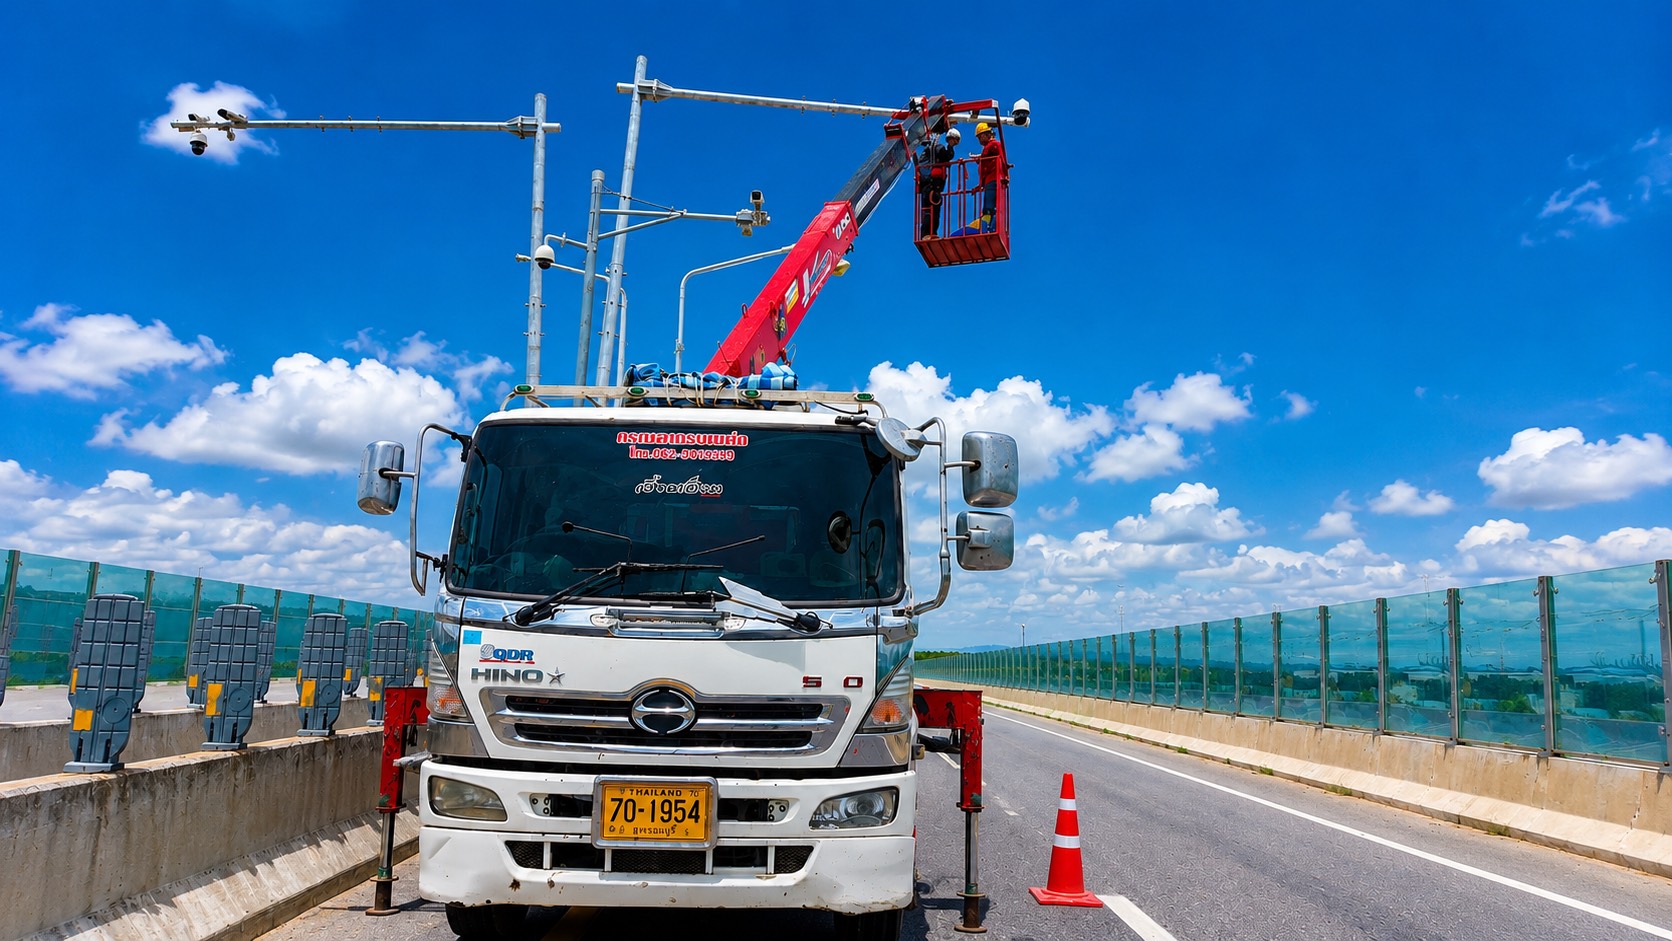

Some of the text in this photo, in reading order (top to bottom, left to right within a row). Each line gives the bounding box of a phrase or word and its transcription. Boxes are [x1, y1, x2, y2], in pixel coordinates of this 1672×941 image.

[493, 648, 534, 661] QDR
[471, 668, 544, 683] HINO
[629, 788, 682, 797] THAILAND
[610, 798, 700, 823] 70-1954
